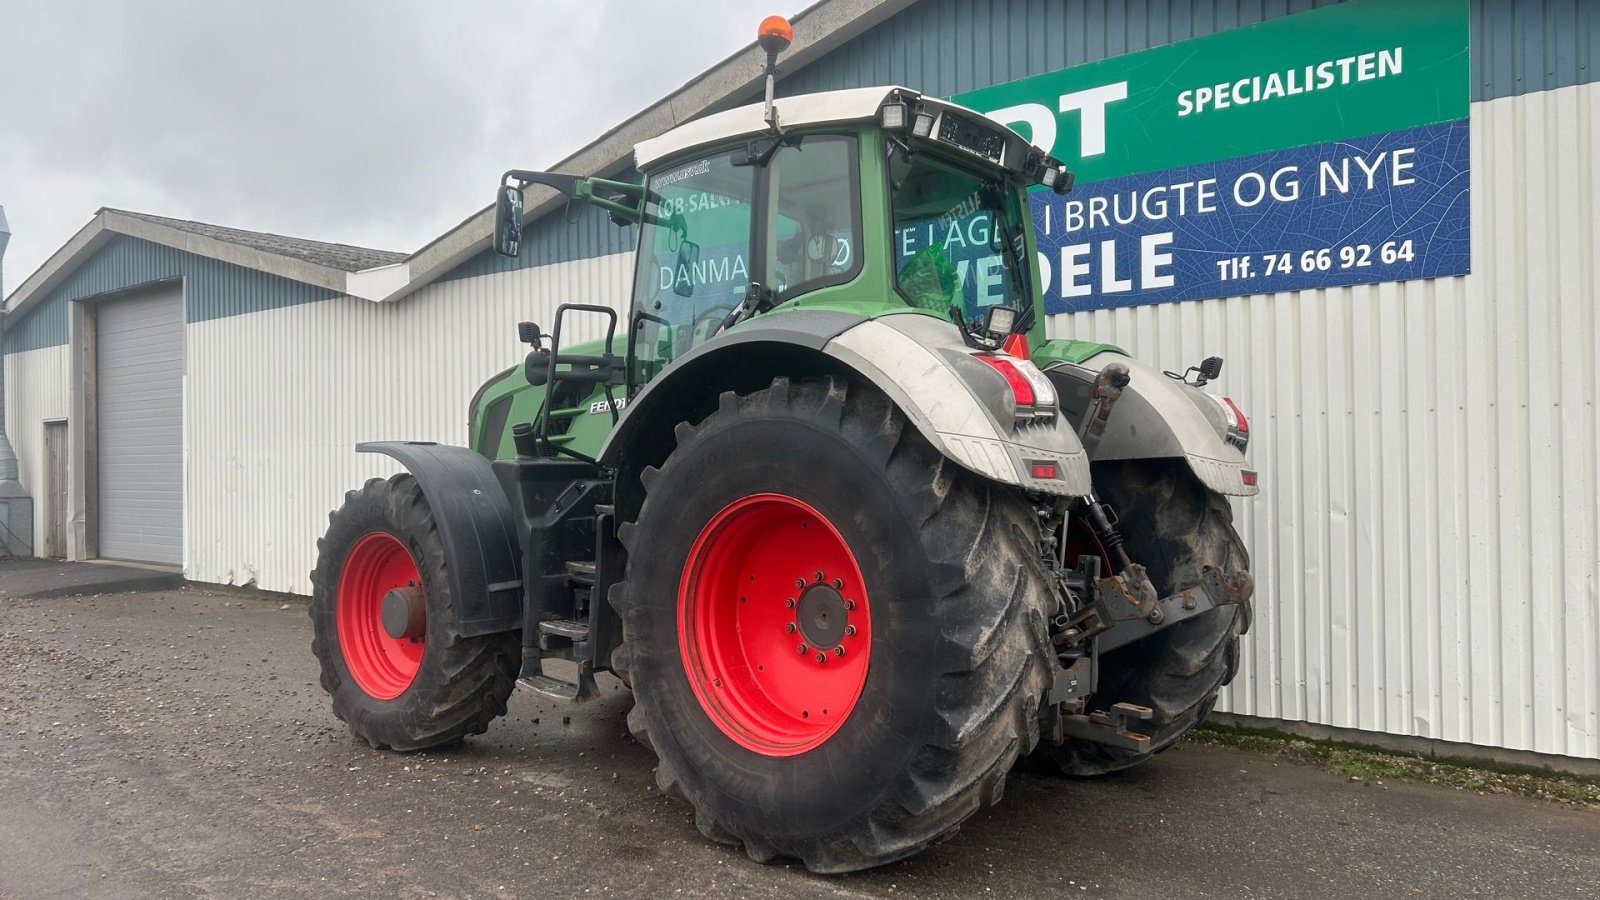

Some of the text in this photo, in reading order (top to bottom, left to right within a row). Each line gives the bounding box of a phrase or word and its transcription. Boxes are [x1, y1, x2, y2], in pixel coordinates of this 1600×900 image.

[984, 80, 1128, 158] DT
[1177, 47, 1402, 117] SPECIALISTEN
[659, 254, 749, 290] DANMA
[1045, 204, 1051, 235] I
[1065, 178, 1217, 233] BRUGTE
[1233, 165, 1299, 207] OG
[1319, 147, 1415, 197] NYE
[1216, 239, 1415, 281] Tlf. 74 66 92 64
